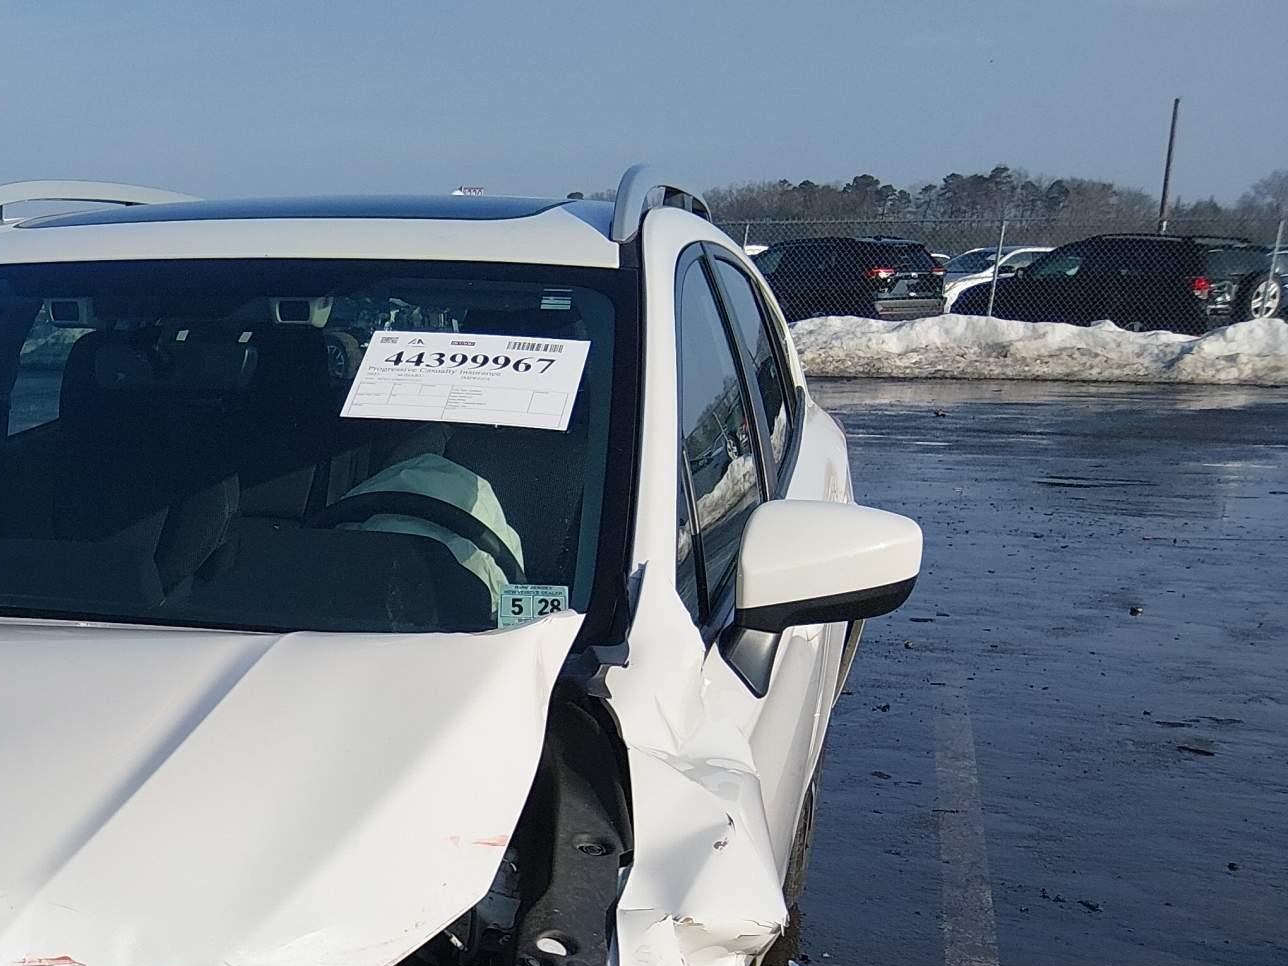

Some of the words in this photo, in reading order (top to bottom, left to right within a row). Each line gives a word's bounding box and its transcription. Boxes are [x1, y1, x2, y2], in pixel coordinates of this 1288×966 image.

[384, 350, 557, 374] 44399967
[419, 367, 457, 376] Casualty
[511, 598, 523, 615] 5
[538, 598, 561, 616] 28
